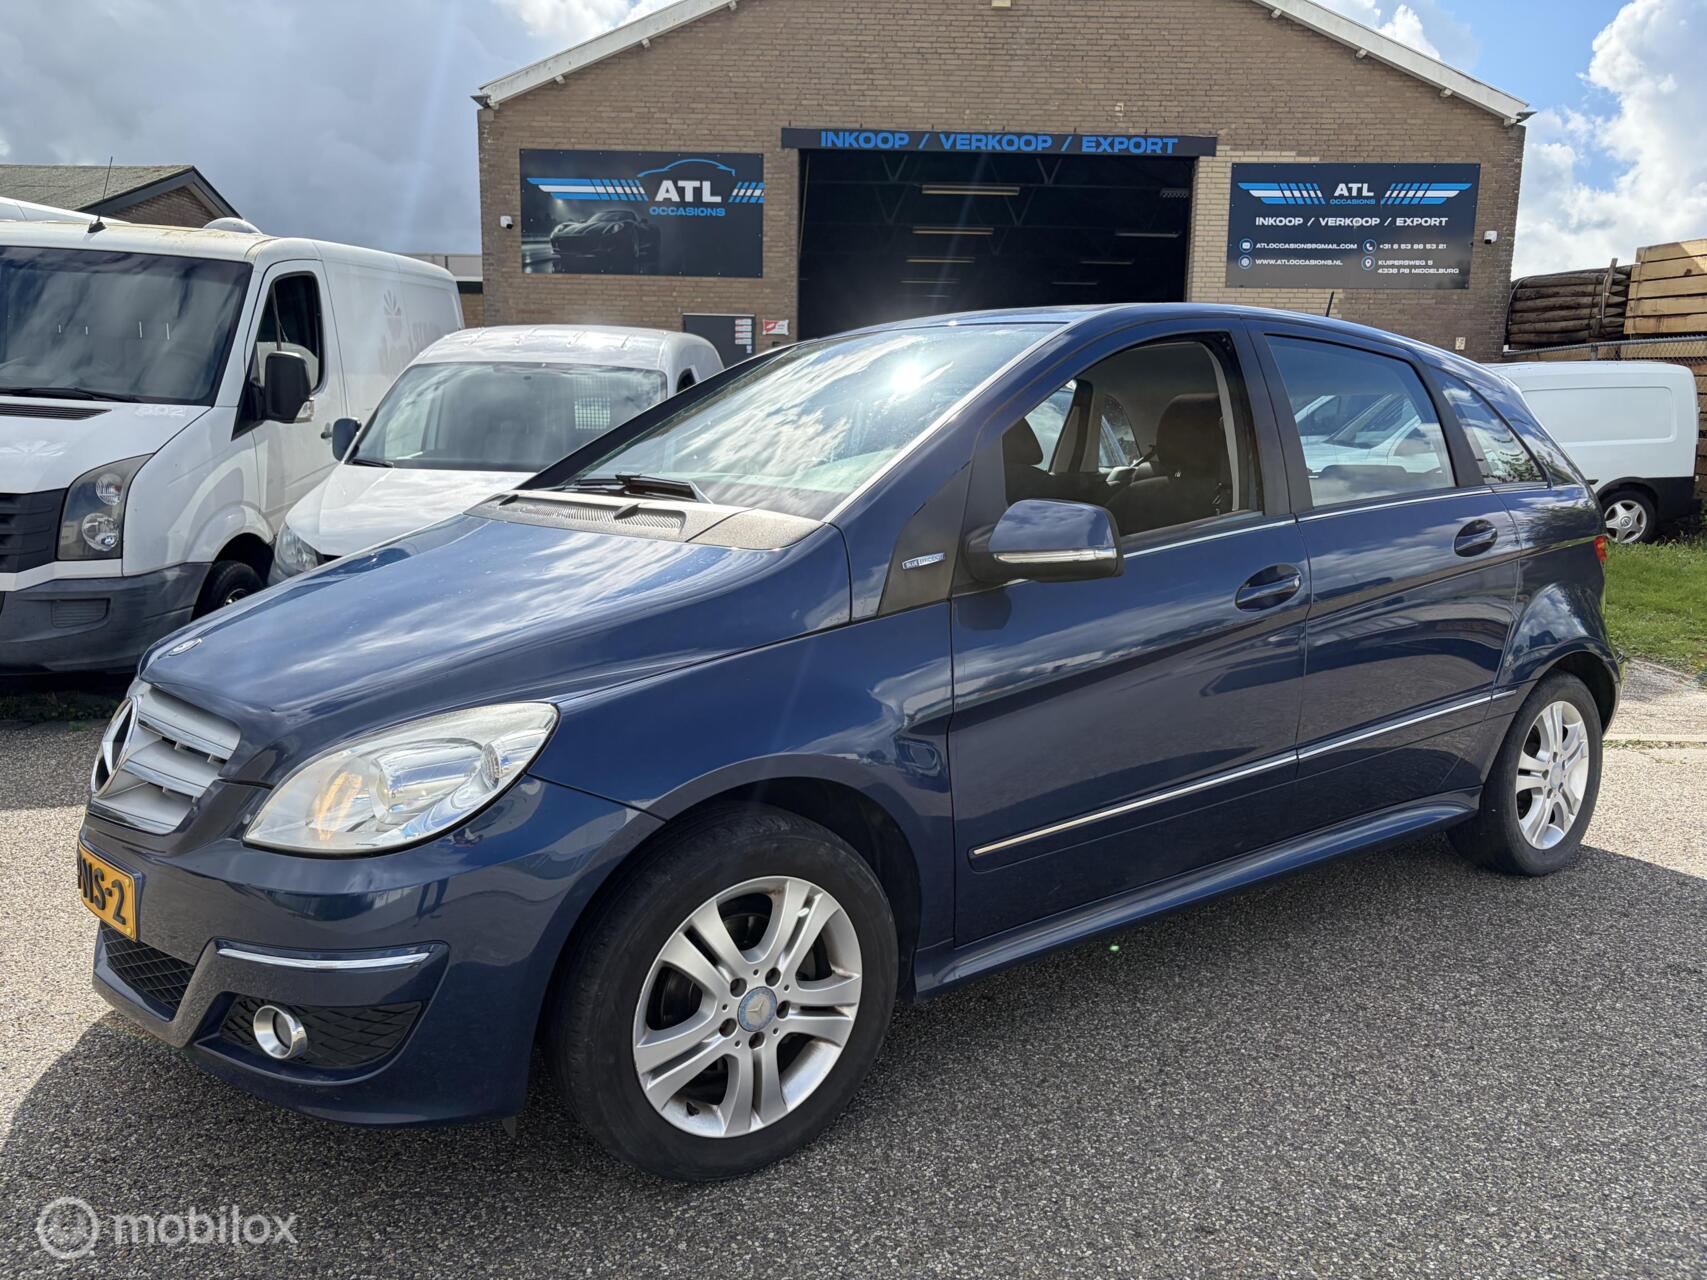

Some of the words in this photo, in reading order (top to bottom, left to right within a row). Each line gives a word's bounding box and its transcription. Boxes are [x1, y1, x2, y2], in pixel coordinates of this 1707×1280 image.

[820, 131, 909, 148] INKOOP
[918, 133, 929, 149] /
[939, 133, 1052, 151] VERKOOP
[1060, 136, 1072, 152] /
[1081, 136, 1178, 154] EXPORT
[655, 180, 722, 203] ATL
[1333, 183, 1374, 197] ATL
[649, 206, 726, 216] OCCASIONS
[1256, 217, 1303, 226] INKOOP
[1319, 217, 1380, 227] VERKOOP
[1396, 217, 1448, 226] EXPORT
